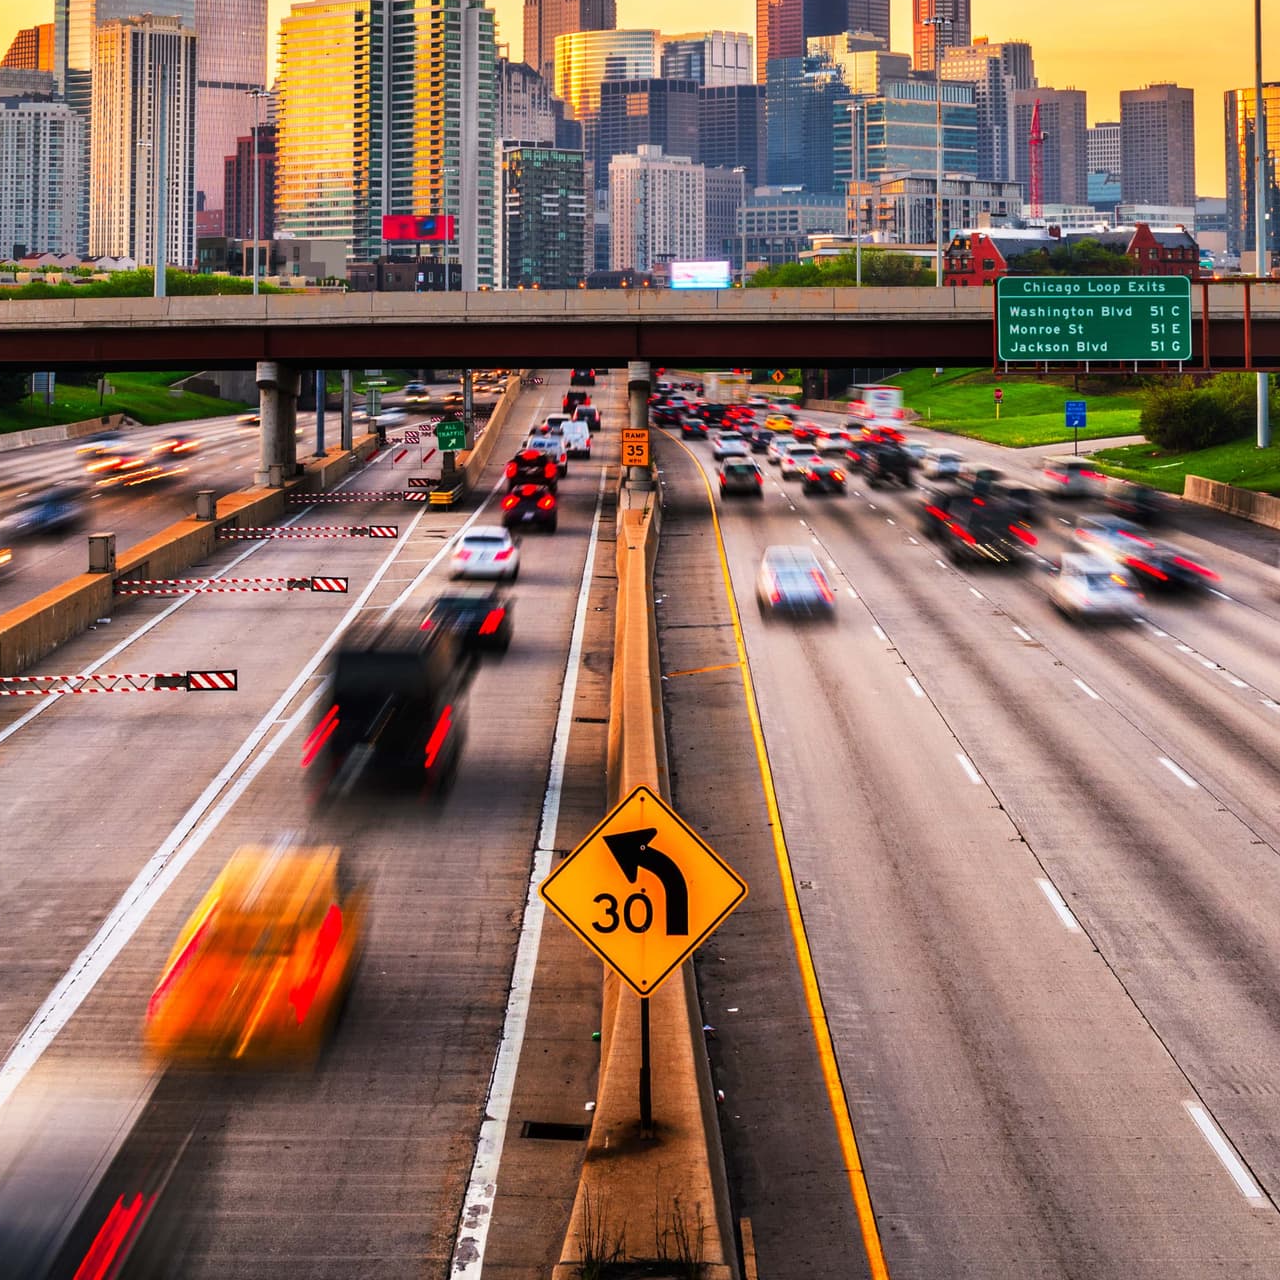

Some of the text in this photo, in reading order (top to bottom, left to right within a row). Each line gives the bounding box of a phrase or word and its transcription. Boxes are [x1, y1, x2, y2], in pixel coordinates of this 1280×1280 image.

[1023, 282, 1165, 295] Chicago Loop Exits
[1009, 306, 1180, 320] Washington Blvd 51 C
[1009, 324, 1180, 334] Monroe St 51 E
[1010, 341, 1180, 352] Jackson Blvd 51 G
[627, 445, 644, 456] 35
[592, 893, 653, 933] 30
